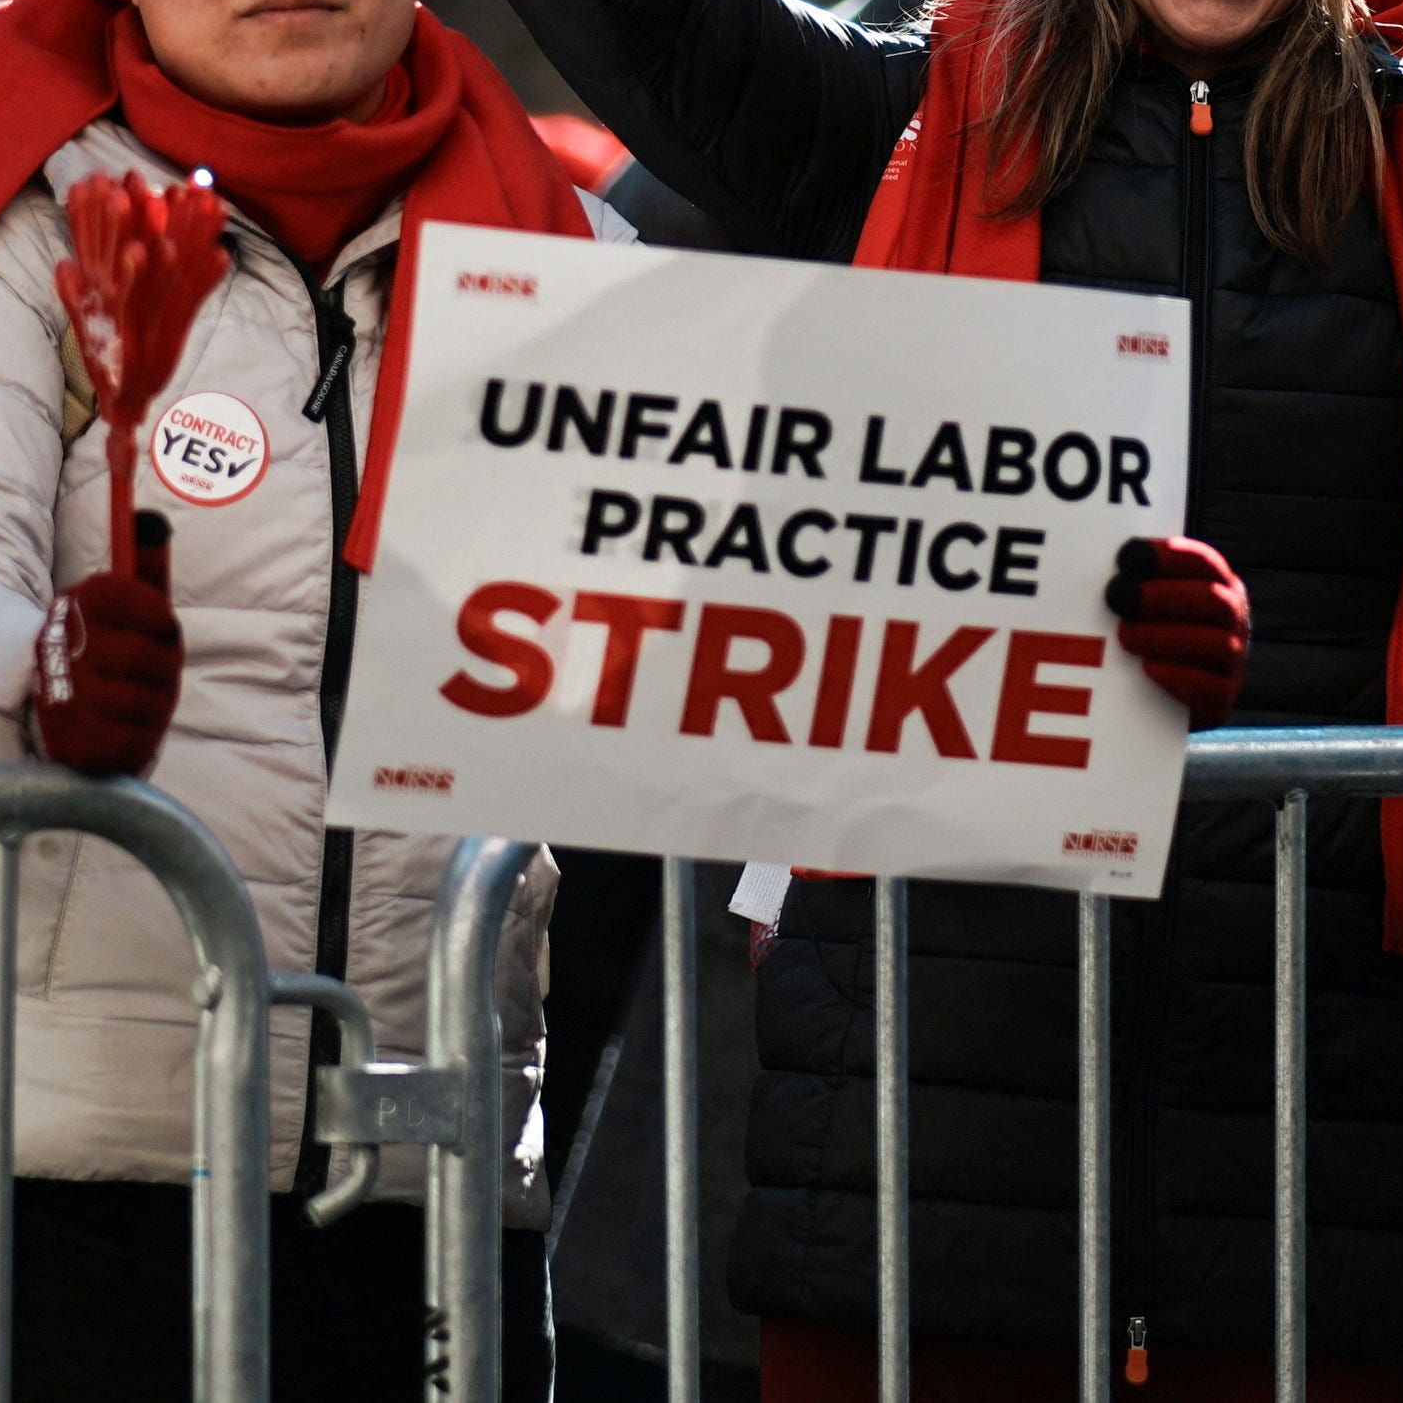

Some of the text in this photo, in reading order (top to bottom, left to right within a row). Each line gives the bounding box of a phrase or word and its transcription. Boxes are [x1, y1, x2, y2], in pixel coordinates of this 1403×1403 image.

[326, 345, 348, 382] CANADA
[1116, 334, 1172, 357] NURSES
[311, 381, 332, 414] GOOSE
[161, 426, 229, 475] YES
[170, 408, 260, 455] CONTRACT
[477, 377, 1152, 508] UNFAIR LABOR
[579, 488, 1048, 598] PRACTICE
[438, 580, 1108, 771] STRIKE
[1062, 831, 1140, 854] NURSES
